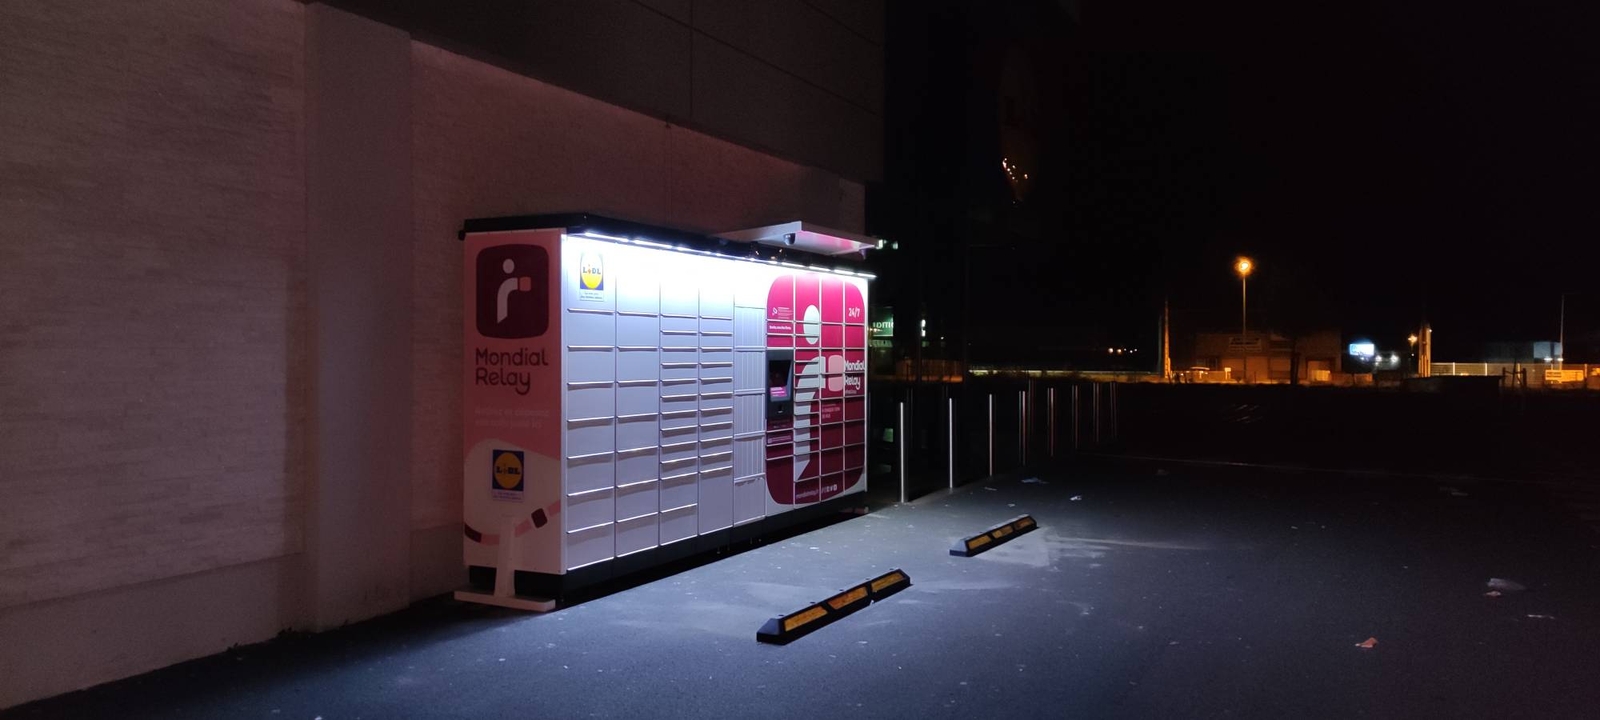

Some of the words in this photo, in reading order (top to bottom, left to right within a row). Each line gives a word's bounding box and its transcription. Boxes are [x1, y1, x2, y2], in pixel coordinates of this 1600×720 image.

[848, 307, 860, 318] 24/7
[475, 347, 549, 366] Mondial
[475, 367, 531, 396] Relay
[845, 375, 861, 390] Relay
